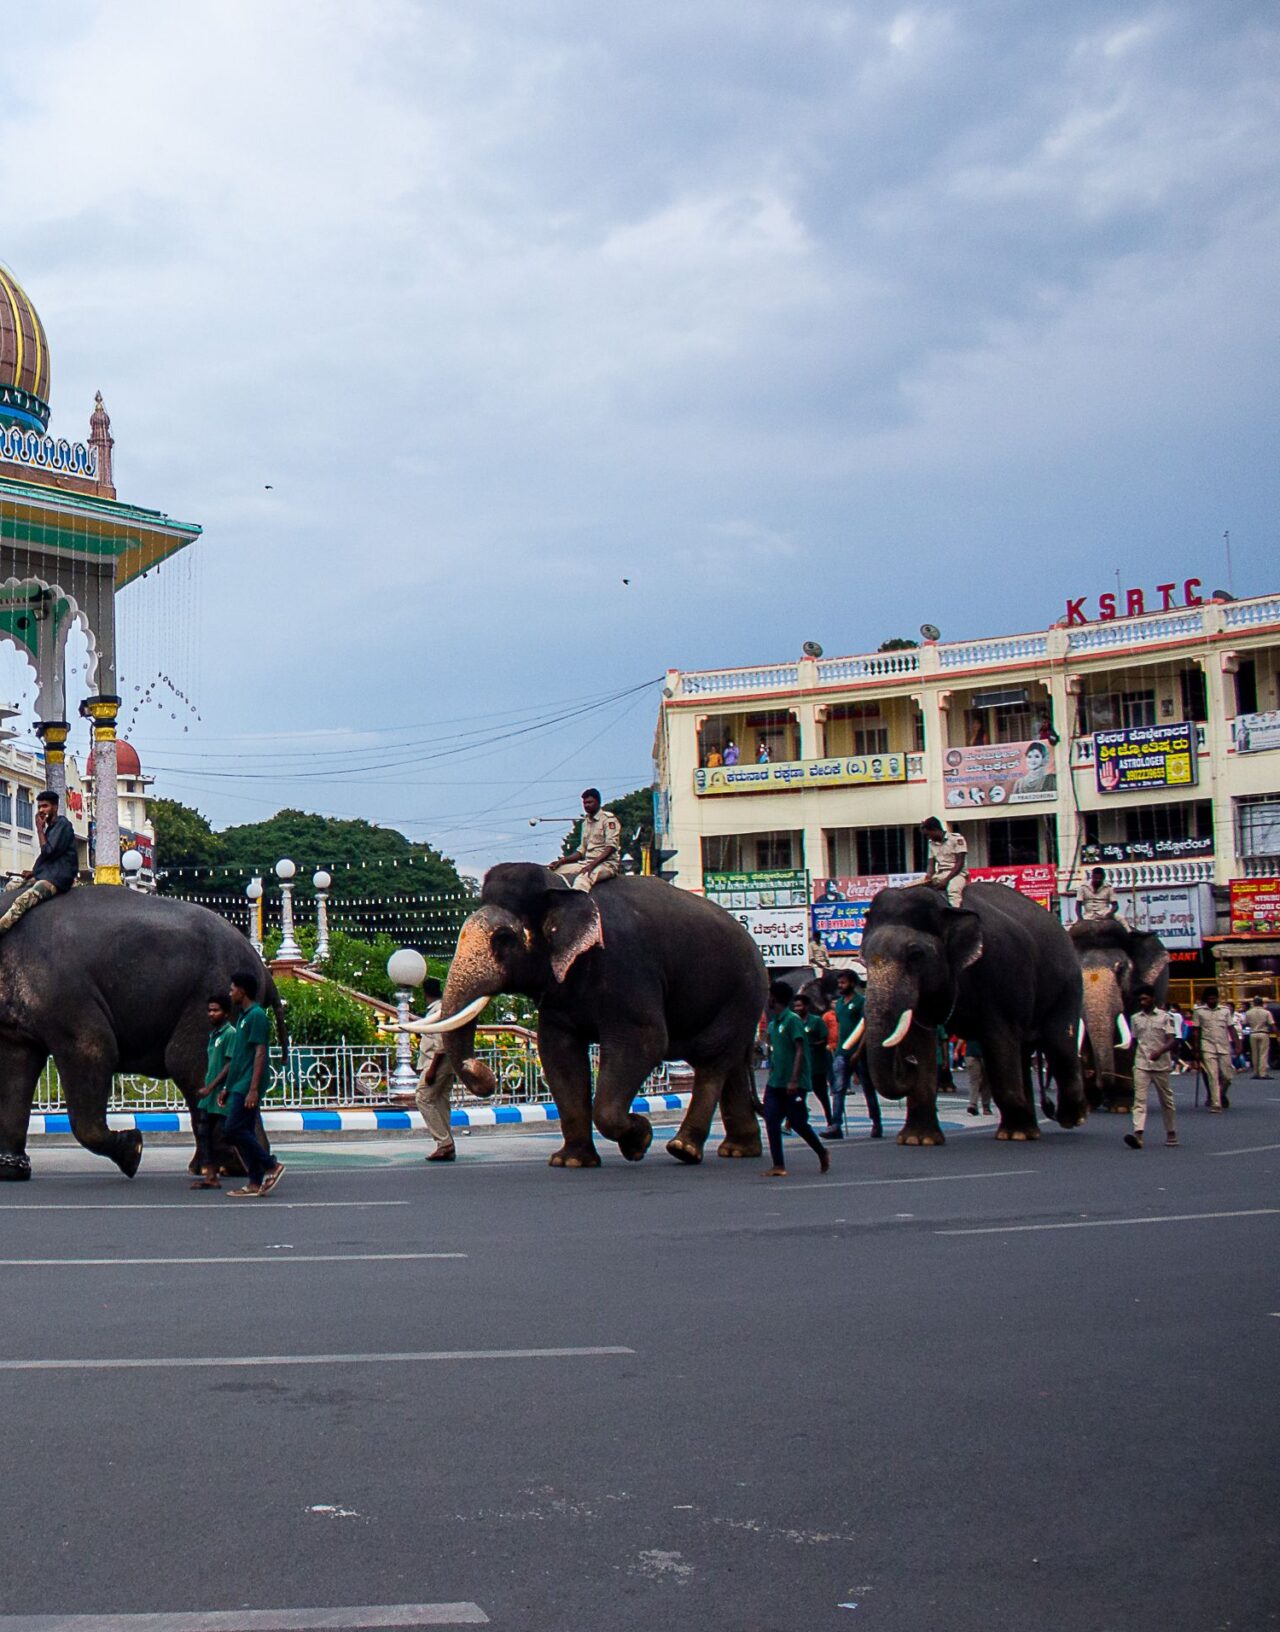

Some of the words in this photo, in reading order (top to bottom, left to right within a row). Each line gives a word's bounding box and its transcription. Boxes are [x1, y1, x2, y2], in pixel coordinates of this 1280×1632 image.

[1066, 578, 1202, 625] KSRTC
[1119, 755, 1164, 769] ASTROLOGER
[809, 763, 841, 777] ವೇದಿಕೆ
[758, 943, 804, 956] EXTILES
